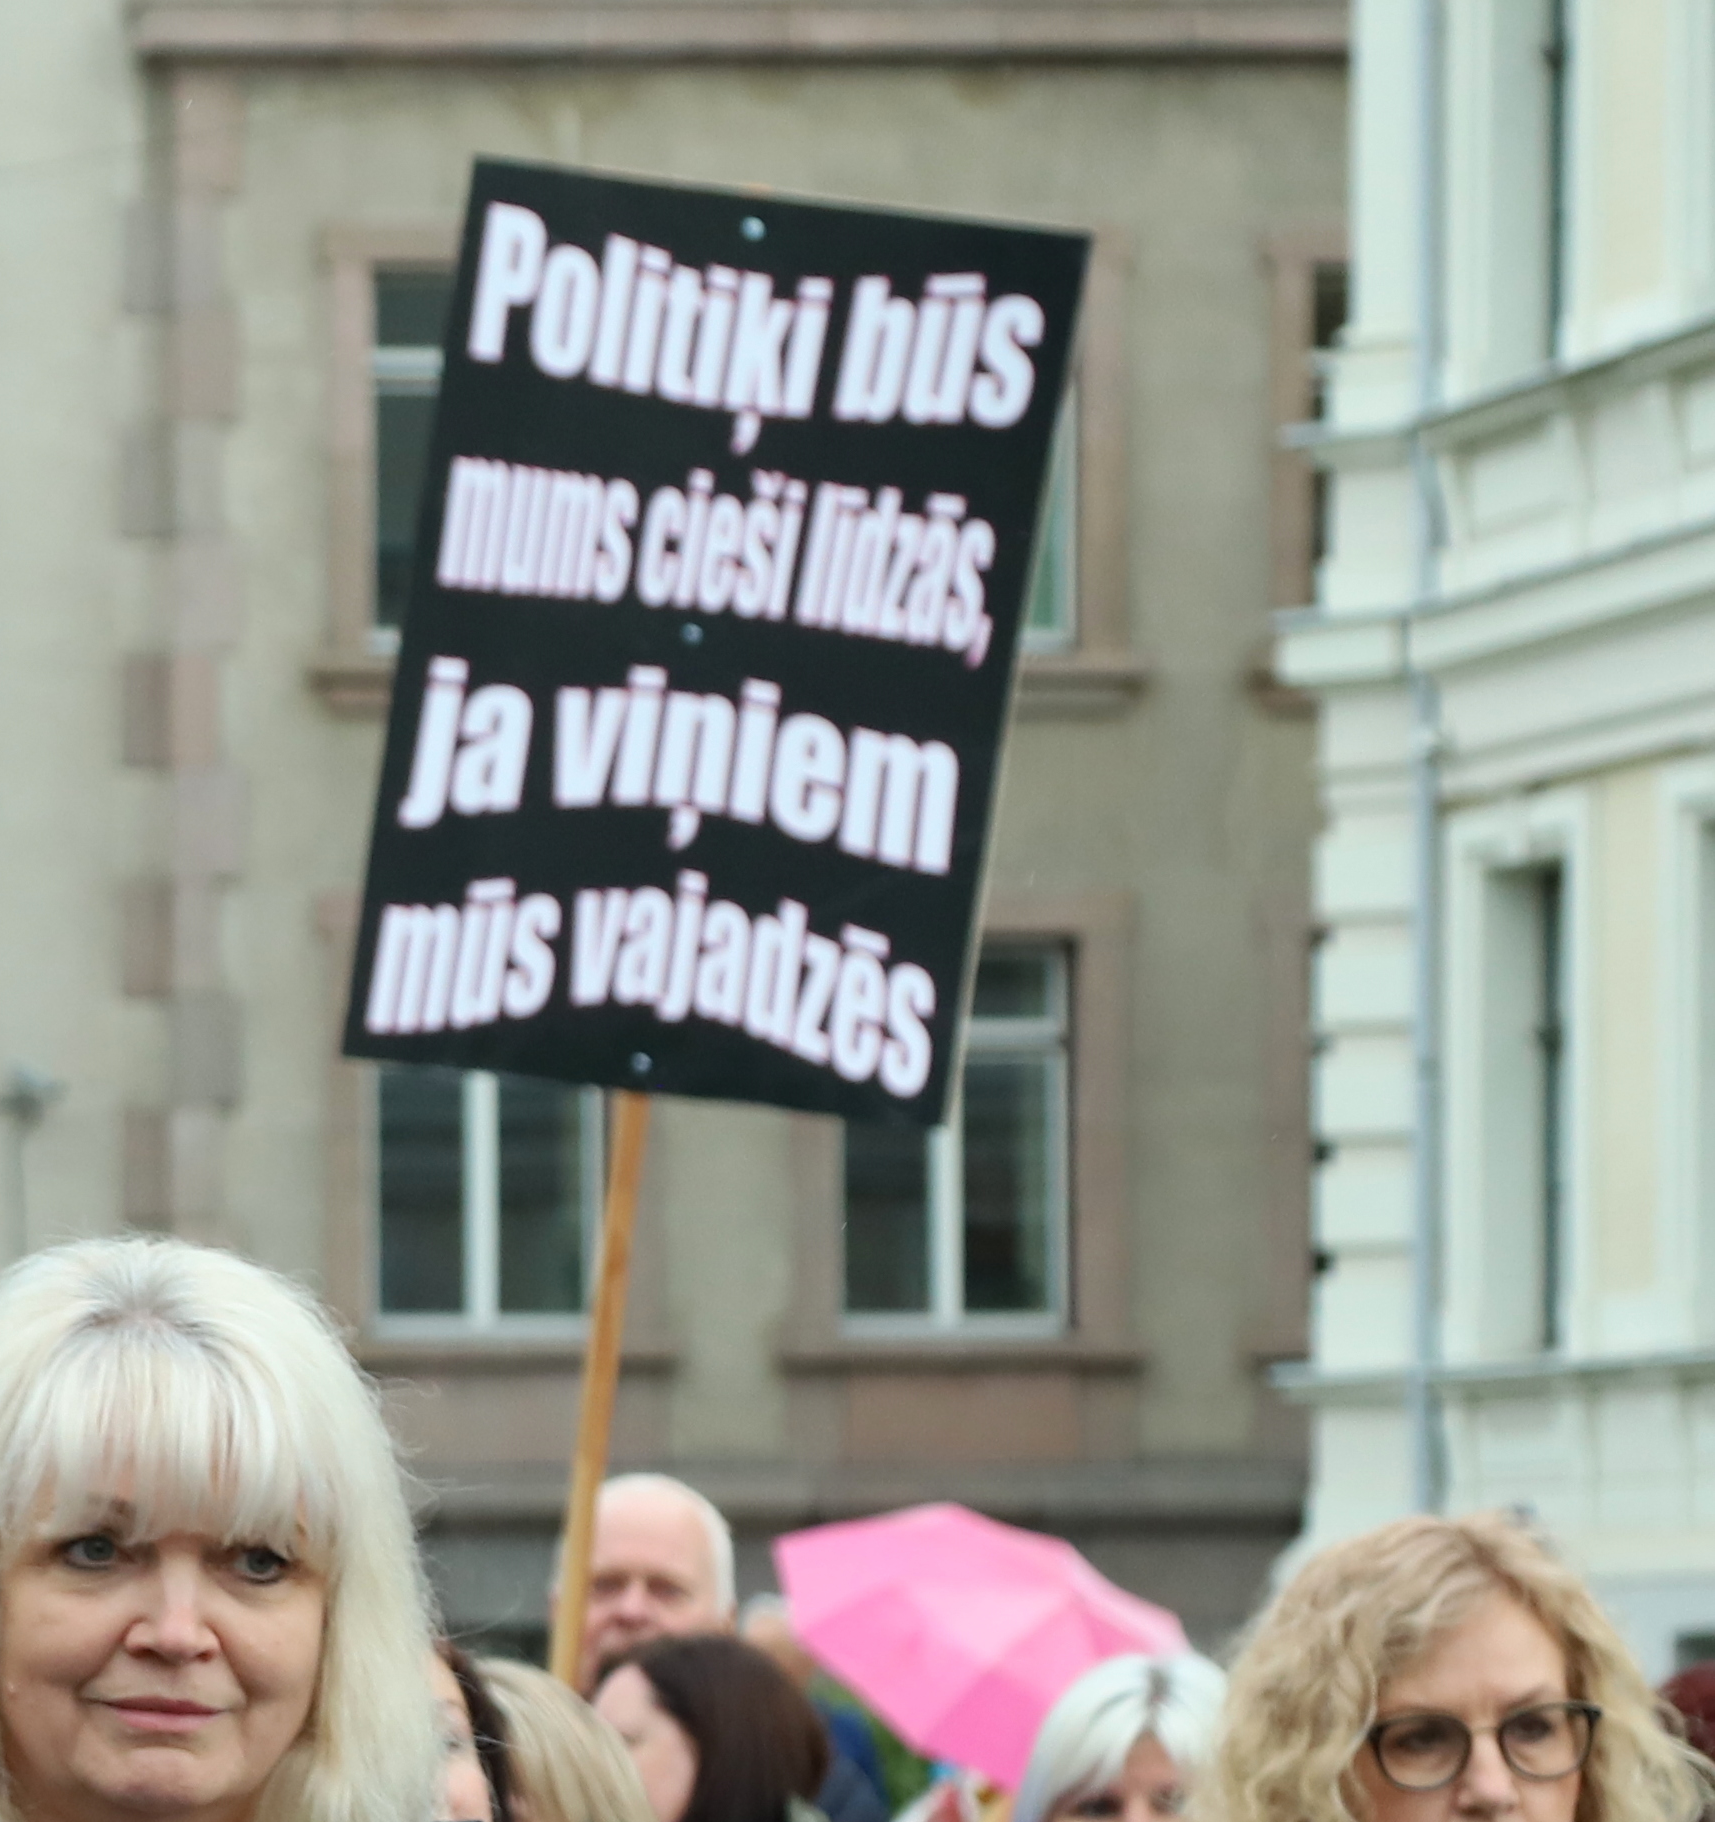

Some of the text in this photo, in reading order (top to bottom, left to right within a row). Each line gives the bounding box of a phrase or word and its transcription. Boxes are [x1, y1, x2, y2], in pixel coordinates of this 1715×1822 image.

[833, 272, 1044, 430] būs
[437, 455, 996, 667] mums cieši līdzās,
[397, 655, 959, 877] ja viņiem
[365, 868, 936, 1099] mūs vajadzēs
